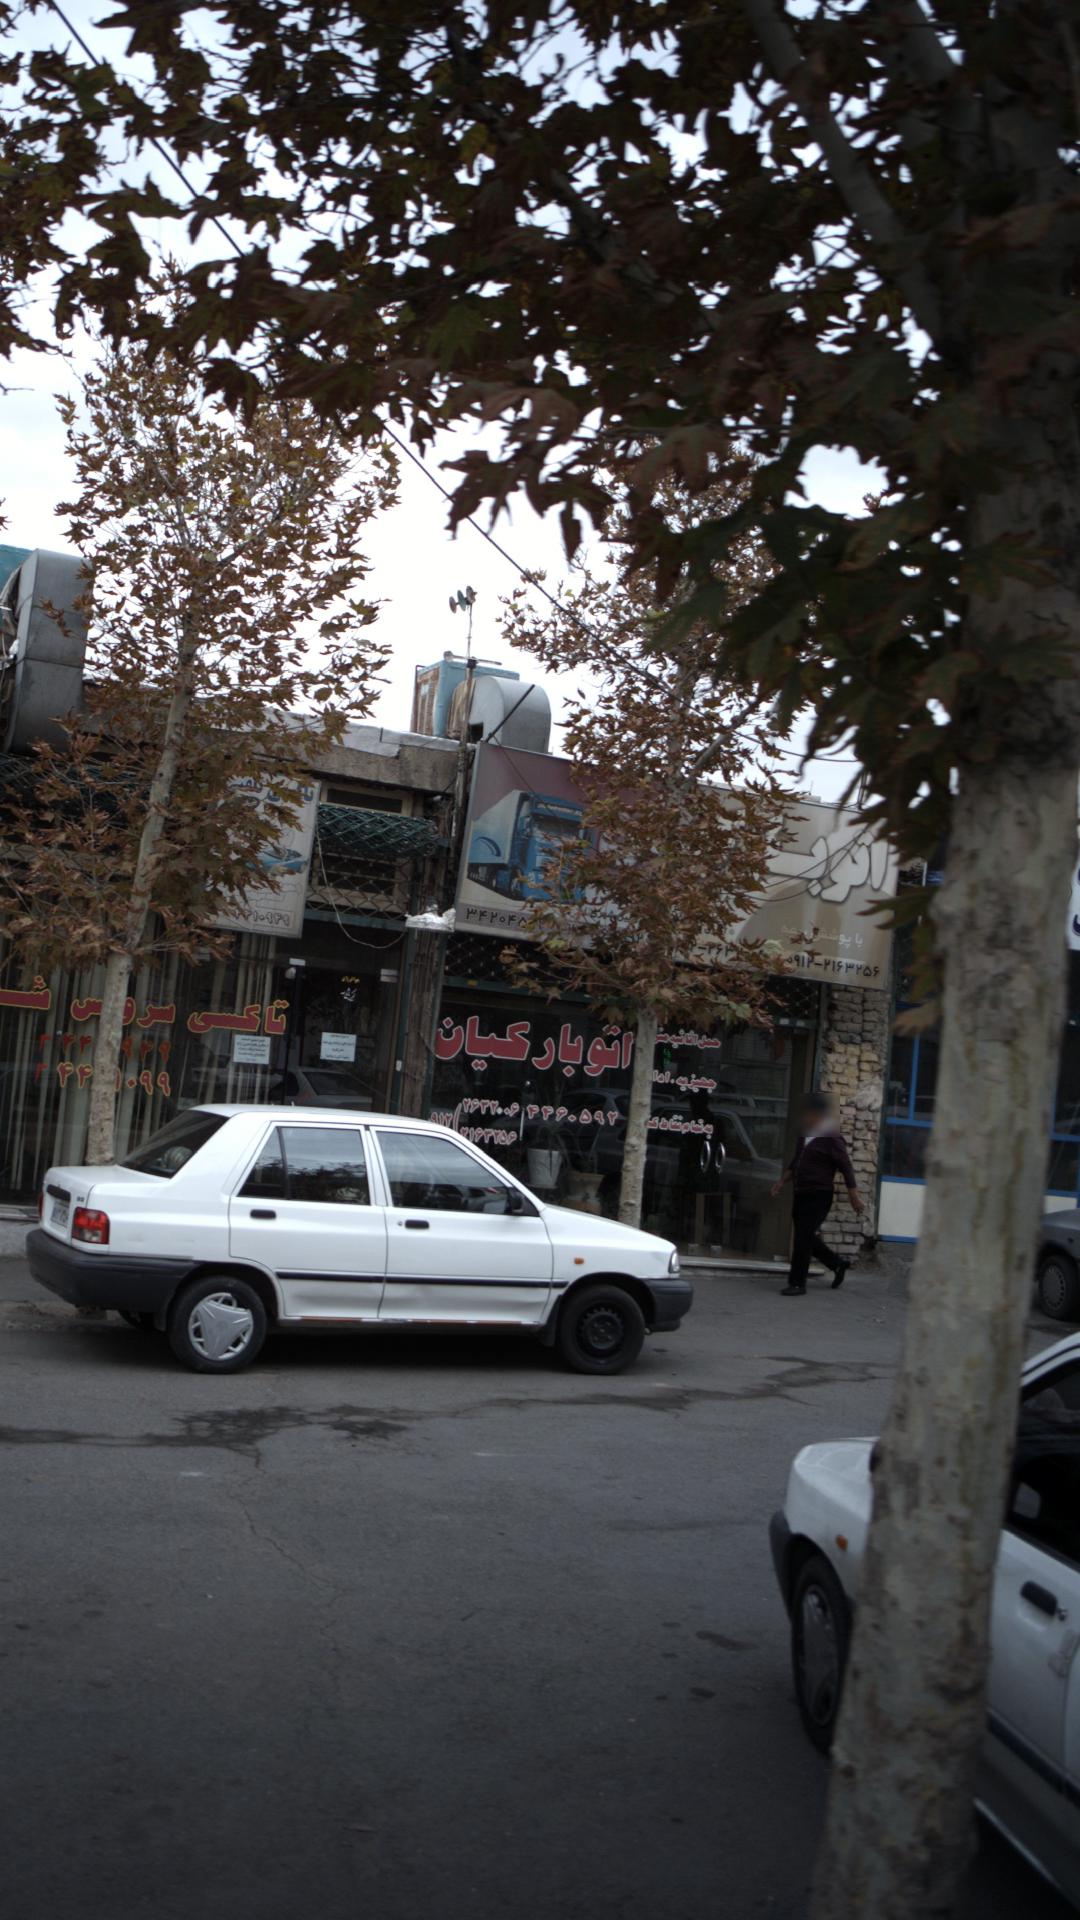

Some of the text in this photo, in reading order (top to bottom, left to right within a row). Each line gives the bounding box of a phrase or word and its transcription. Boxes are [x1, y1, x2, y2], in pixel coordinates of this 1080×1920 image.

[70, 997, 176, 1028] سروس
[187, 999, 290, 1035] تاکسی
[434, 1015, 531, 1072] کیان
[652, 1069, 671, 1084] ادا
[526, 1103, 619, 1126] ۴۴۶۰۵۹۲
